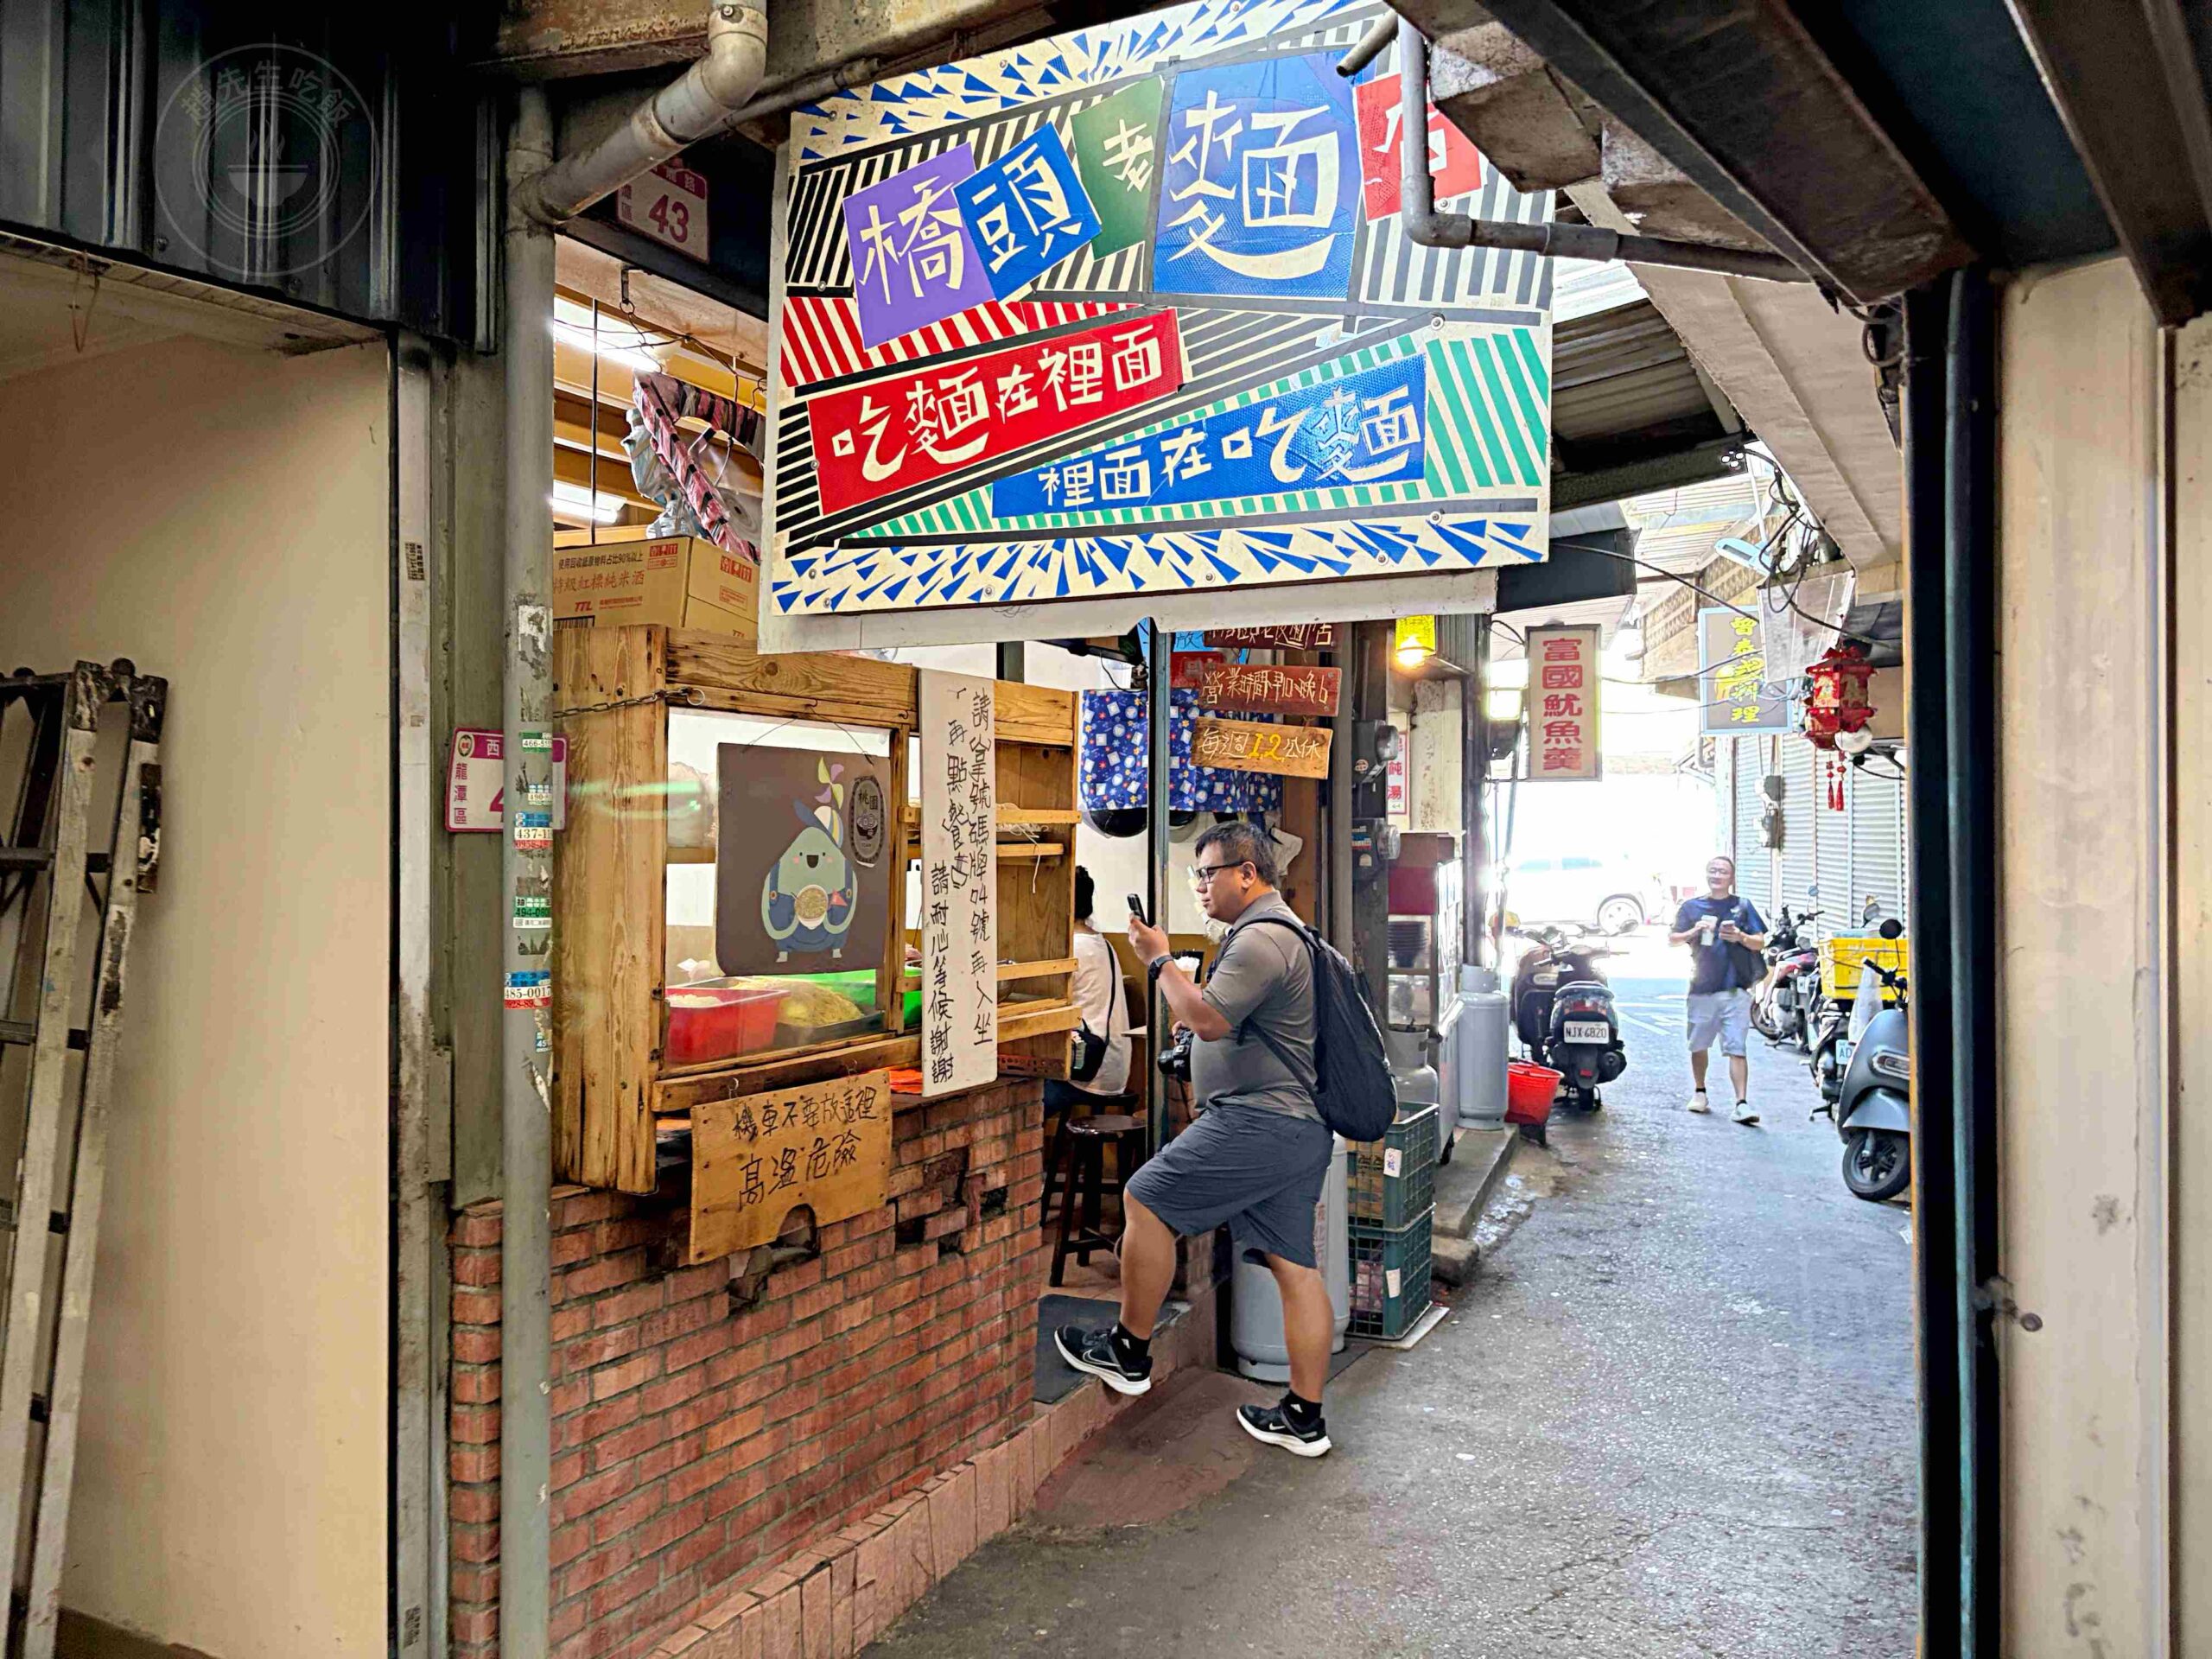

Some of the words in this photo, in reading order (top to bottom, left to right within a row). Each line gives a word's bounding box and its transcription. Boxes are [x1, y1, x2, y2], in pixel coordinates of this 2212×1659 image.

[649, 194, 690, 243] 43
[833, 326, 1162, 481] 吃麵在裡面
[1037, 385, 1420, 507] 裡面在吃麵
[1542, 638, 1583, 771] 富國魷魚羹
